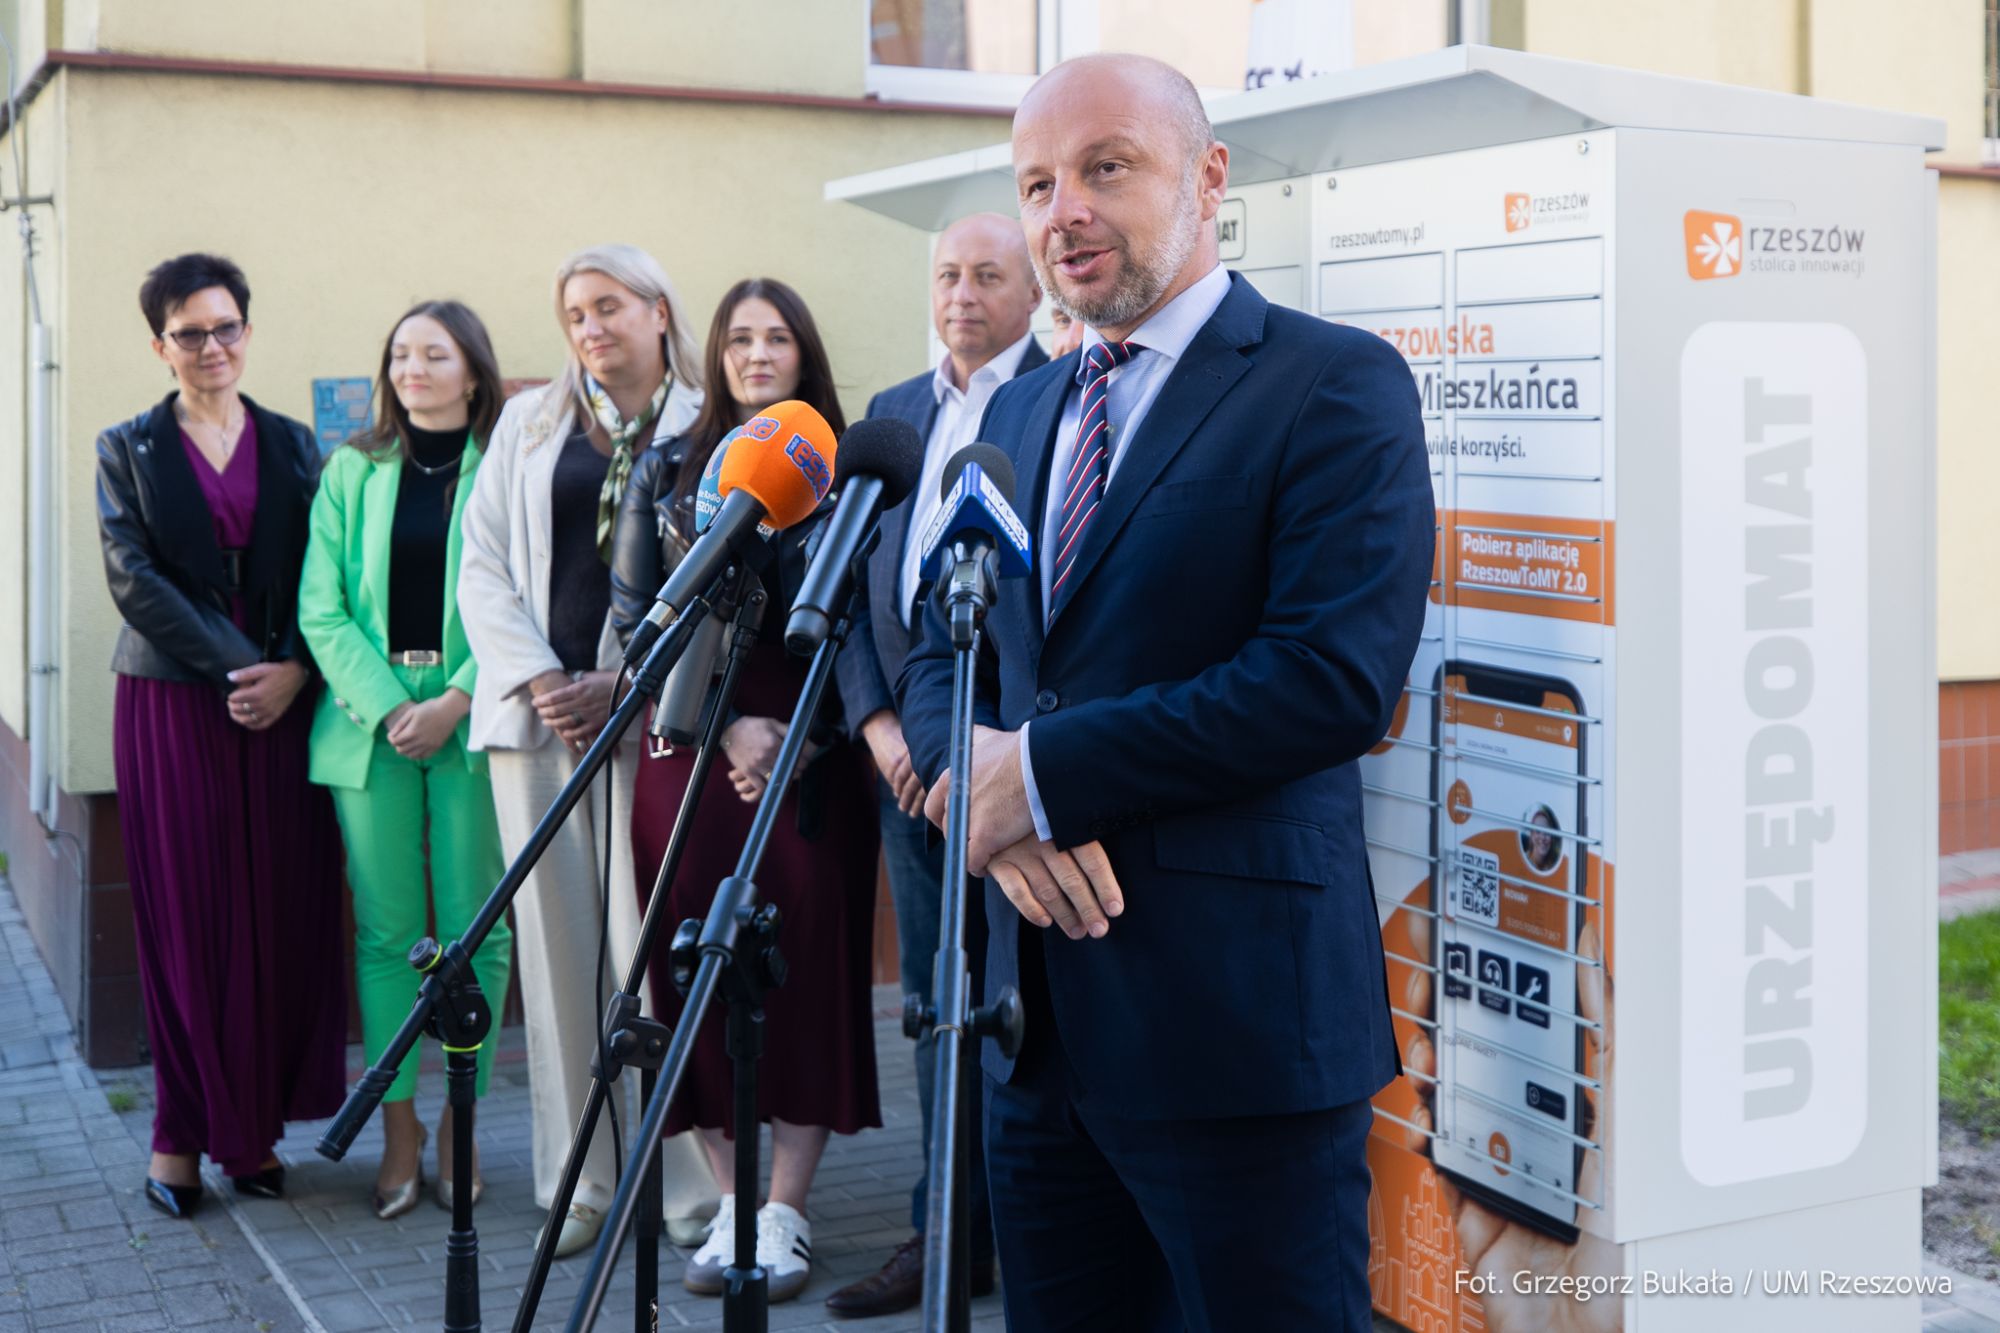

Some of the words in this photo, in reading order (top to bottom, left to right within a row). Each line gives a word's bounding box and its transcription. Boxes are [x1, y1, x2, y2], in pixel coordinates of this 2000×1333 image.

[1217, 219, 1238, 241] AT
[1331, 222, 1425, 248] rzeszowtomy.pl
[1750, 225, 1865, 252] rzeszów
[1750, 257, 1796, 272] stolica
[1801, 257, 1865, 279] innowacji
[1414, 363, 1579, 410] Mieszkańca
[1461, 434, 1526, 462] korzyści.
[1462, 532, 1512, 557] Pobierz
[1516, 539, 1580, 568] aplikację
[1461, 560, 1561, 589] RzeszowToMY
[1563, 571, 1588, 593] 2.0
[1743, 376, 1836, 1122] URZĘDOMAT
